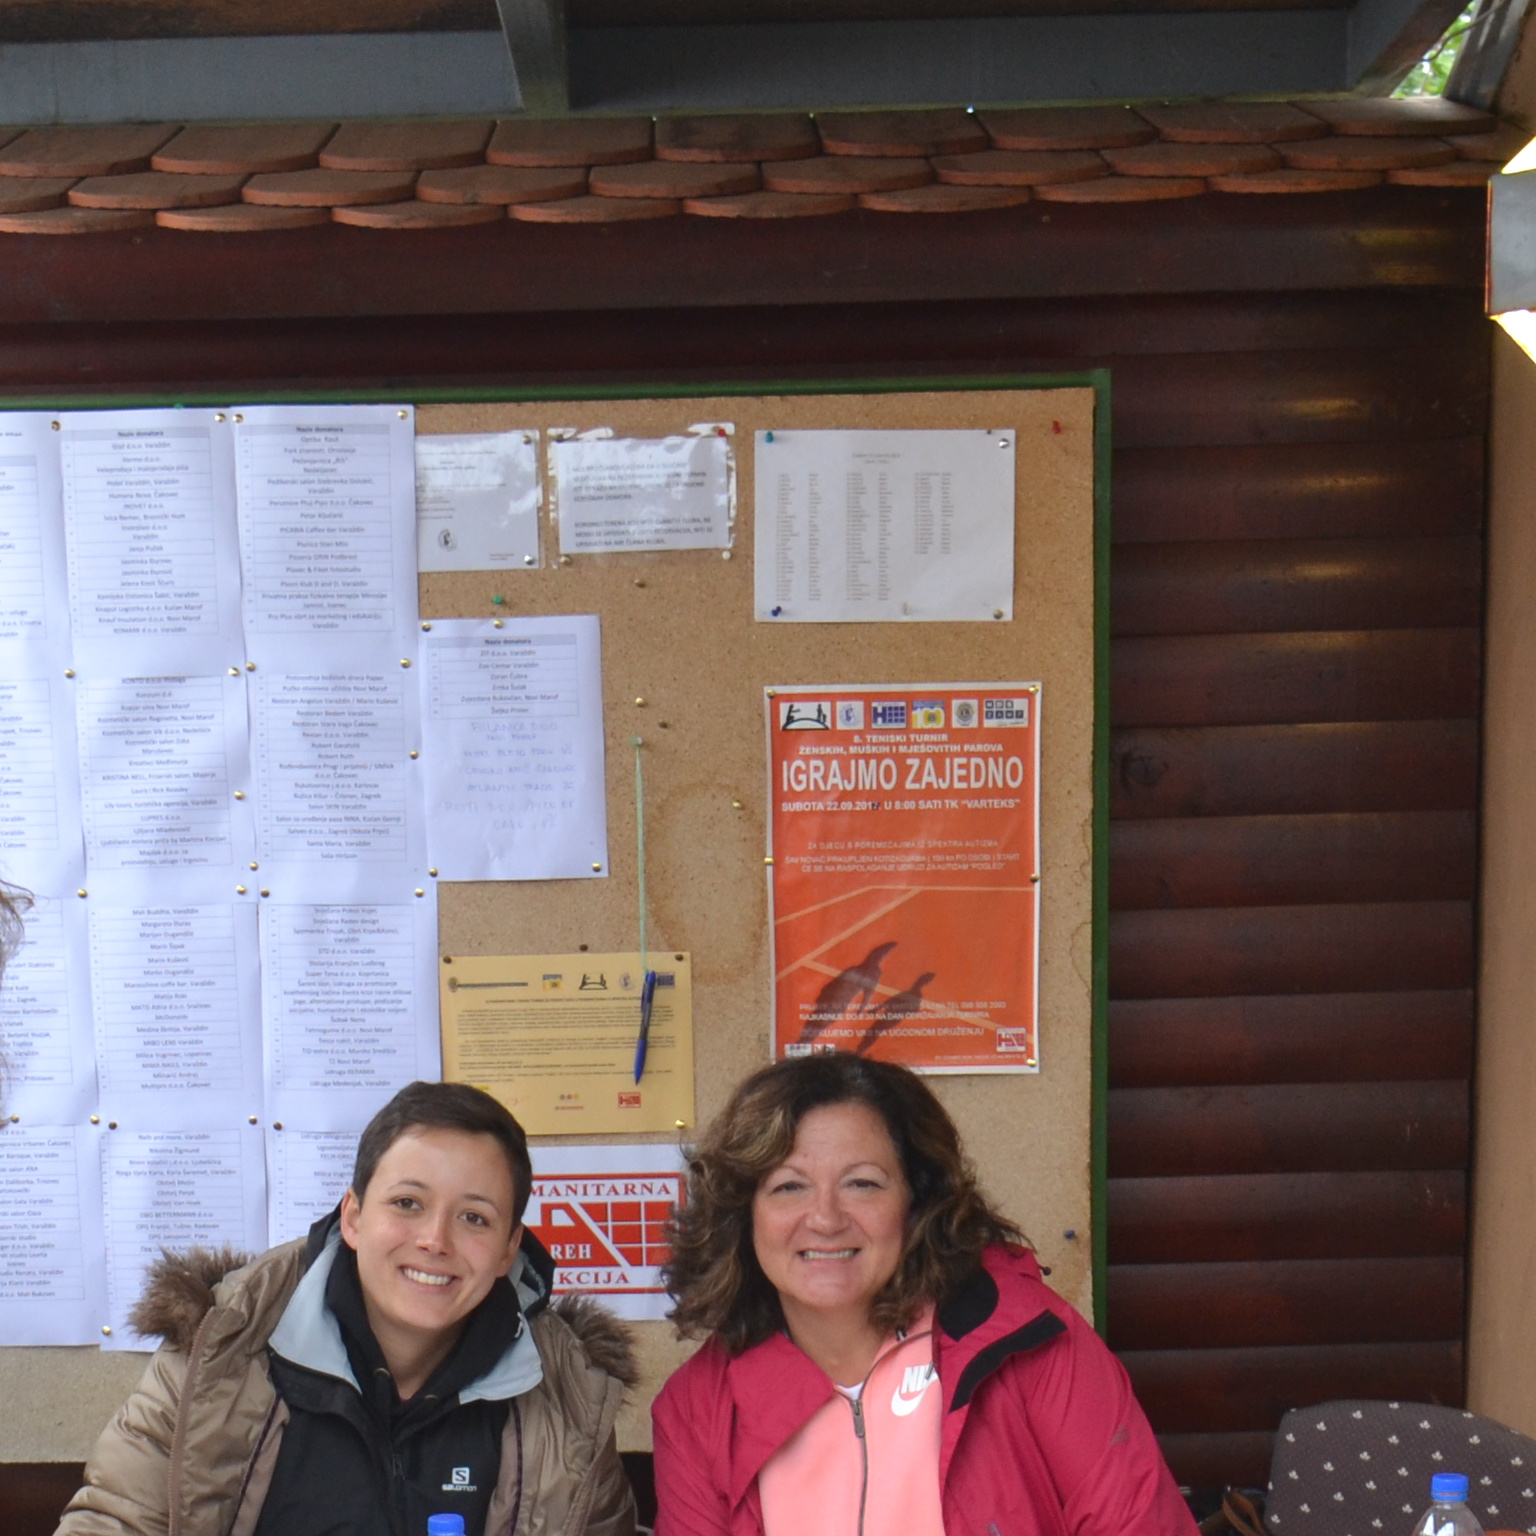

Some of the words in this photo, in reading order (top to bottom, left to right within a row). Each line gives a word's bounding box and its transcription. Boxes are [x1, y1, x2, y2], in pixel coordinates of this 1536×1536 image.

[865, 734, 907, 743] TENISKI
[910, 733, 949, 742] TURNIR
[799, 744, 847, 755] ŽENSKIH,
[849, 743, 890, 754] MUŠKIH
[898, 742, 961, 754] MJEŠOVITIH
[963, 743, 1004, 752] PAROVA
[782, 758, 898, 792] IGRAJMO
[905, 755, 1024, 790] ZAJEDNO
[782, 801, 825, 812] SUBOTA
[883, 800, 893, 810] U
[918, 799, 943, 809] SATI
[944, 799, 959, 809] TK
[937, 1026, 984, 1036] DRUŽENJU
[531, 1182, 671, 1198] MANITARNA
[550, 1243, 593, 1260] REH
[558, 1271, 632, 1285] KCIJA
